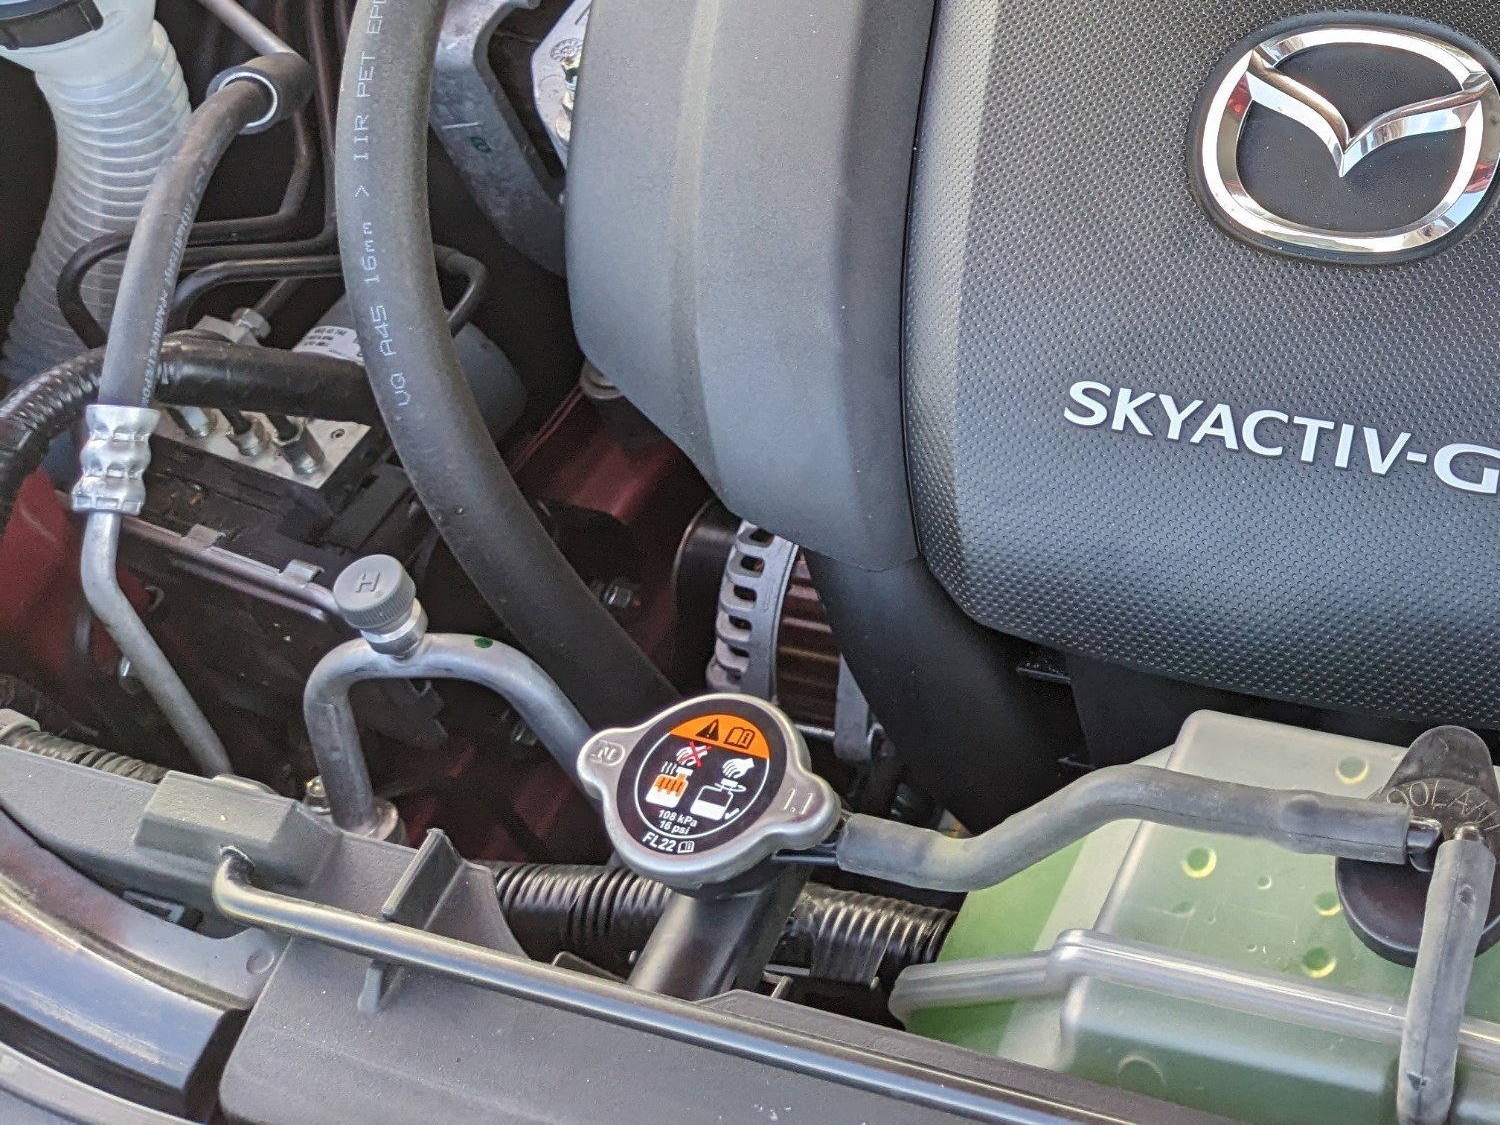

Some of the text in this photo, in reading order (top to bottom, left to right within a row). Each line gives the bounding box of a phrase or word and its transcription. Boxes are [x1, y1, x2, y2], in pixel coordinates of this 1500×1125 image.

[355, 51, 376, 98] PET
[360, 222, 382, 284] 16mm
[355, 570, 381, 593] H
[658, 809, 698, 828] 108 kPa
[659, 819, 691, 835] 16 psi
[641, 831, 677, 852] FL22
